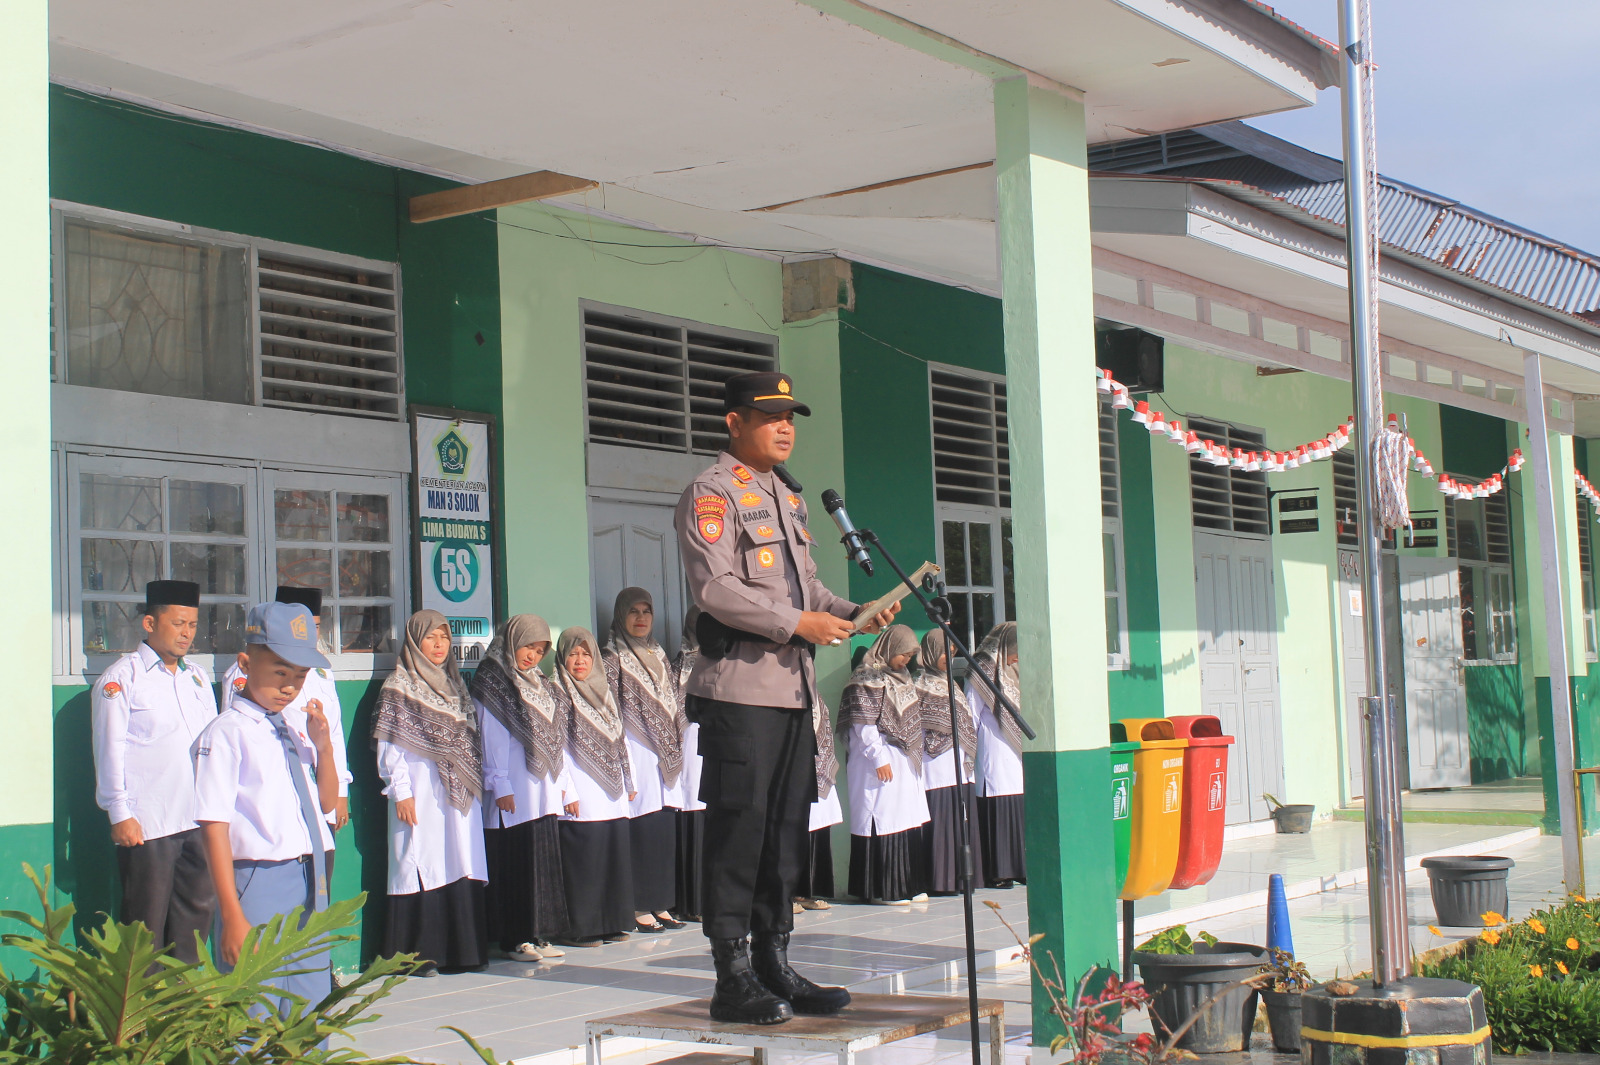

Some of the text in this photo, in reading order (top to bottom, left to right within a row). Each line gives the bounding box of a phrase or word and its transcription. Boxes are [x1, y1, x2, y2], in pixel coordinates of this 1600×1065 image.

[420, 477, 487, 492] KEMENTERIAN AGAMA
[427, 490, 480, 512] MAN 3 SOLOK
[422, 522, 487, 541] LIMA BUDAYA S
[441, 548, 472, 594] 5S
[449, 619, 483, 635] ENYUM
[453, 646, 480, 660] ALAM
